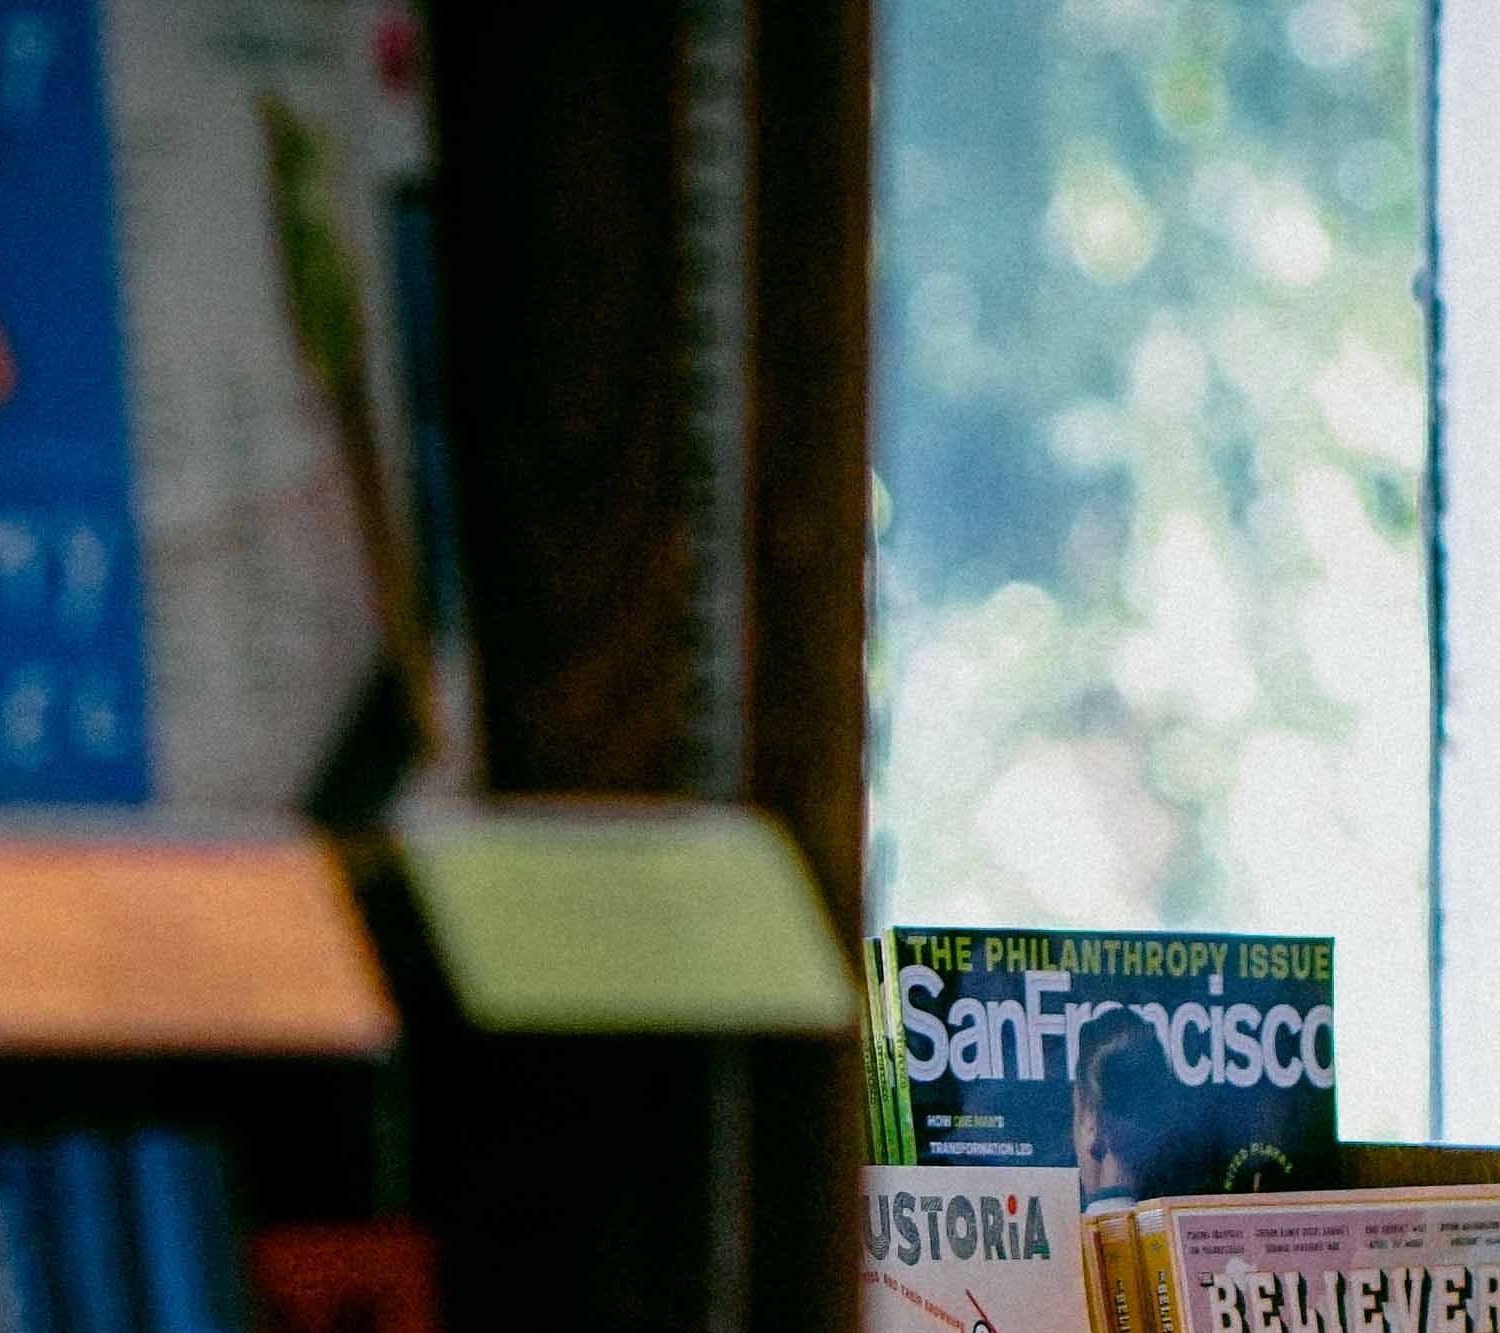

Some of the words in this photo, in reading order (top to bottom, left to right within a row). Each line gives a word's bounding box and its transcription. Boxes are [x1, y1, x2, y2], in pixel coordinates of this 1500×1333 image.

[908, 935, 973, 972] THE
[985, 938, 1229, 977] PHILANTHROPY
[1239, 943, 1331, 981] ISSUE
